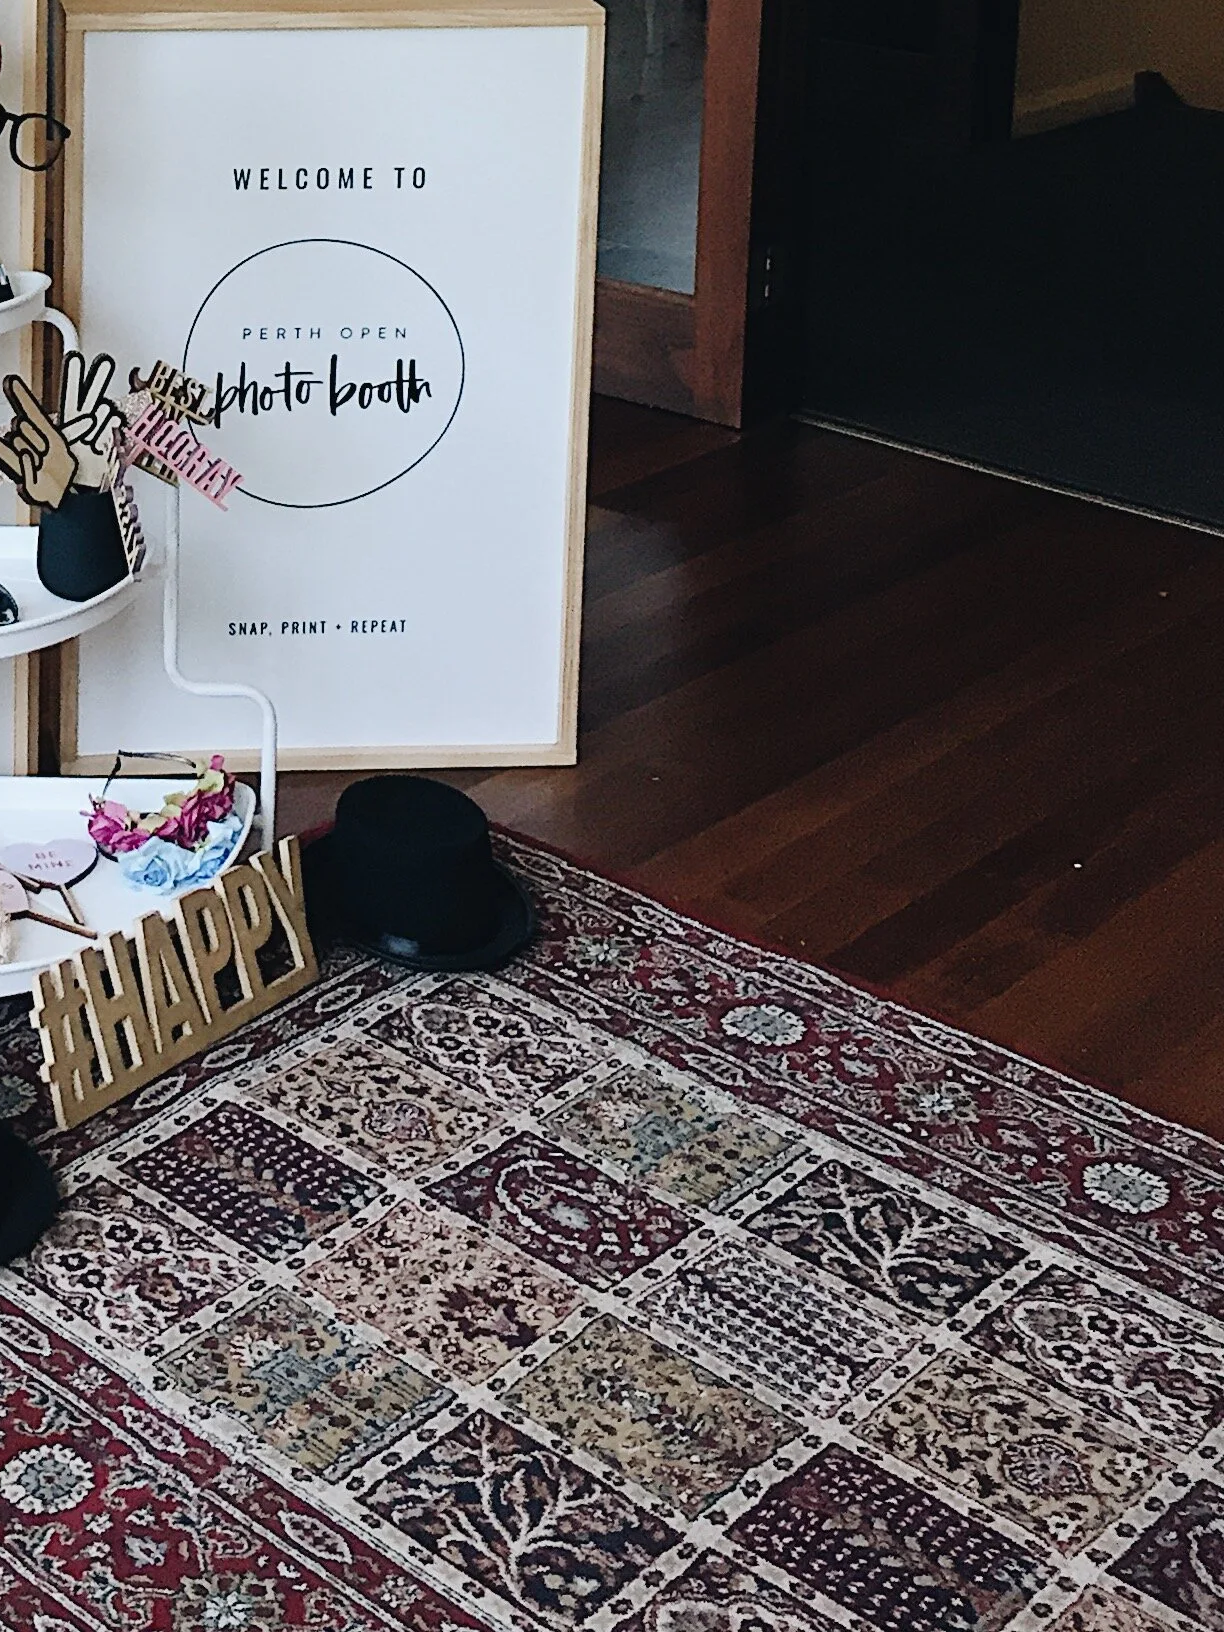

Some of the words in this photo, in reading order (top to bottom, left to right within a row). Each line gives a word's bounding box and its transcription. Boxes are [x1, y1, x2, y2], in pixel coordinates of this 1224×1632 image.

[233, 167, 373, 190] WELCOME
[394, 167, 427, 189] TO
[242, 327, 321, 340] PERTH
[340, 326, 407, 339] OPEN
[149, 358, 215, 419] BEST
[214, 361, 324, 429] photo
[329, 353, 432, 416] booth
[126, 402, 246, 511] HOORAY
[281, 621, 327, 634] PRINT
[350, 620, 407, 633] REPEAT
[30, 835, 317, 1130] #HAPPY
